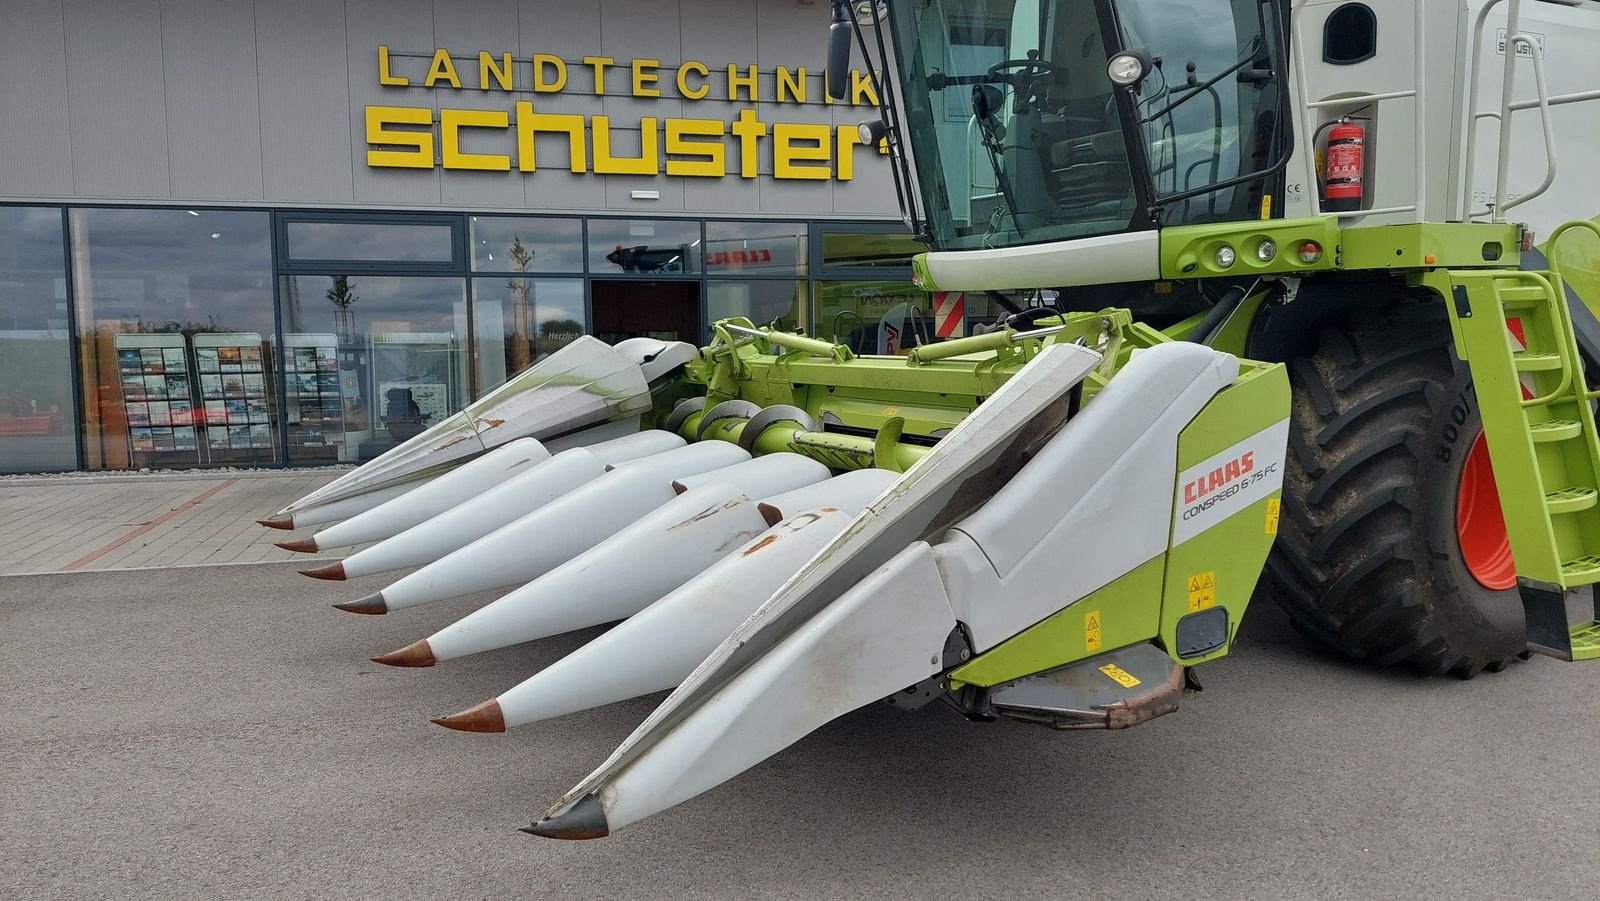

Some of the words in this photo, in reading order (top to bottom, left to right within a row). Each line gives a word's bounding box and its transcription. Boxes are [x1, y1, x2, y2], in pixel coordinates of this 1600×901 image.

[548, 332, 580, 341] Herzlich
[1183, 484, 1240, 521] CONSPEED
[1265, 462, 1277, 476] FC
[1184, 451, 1254, 505] CLAAS
